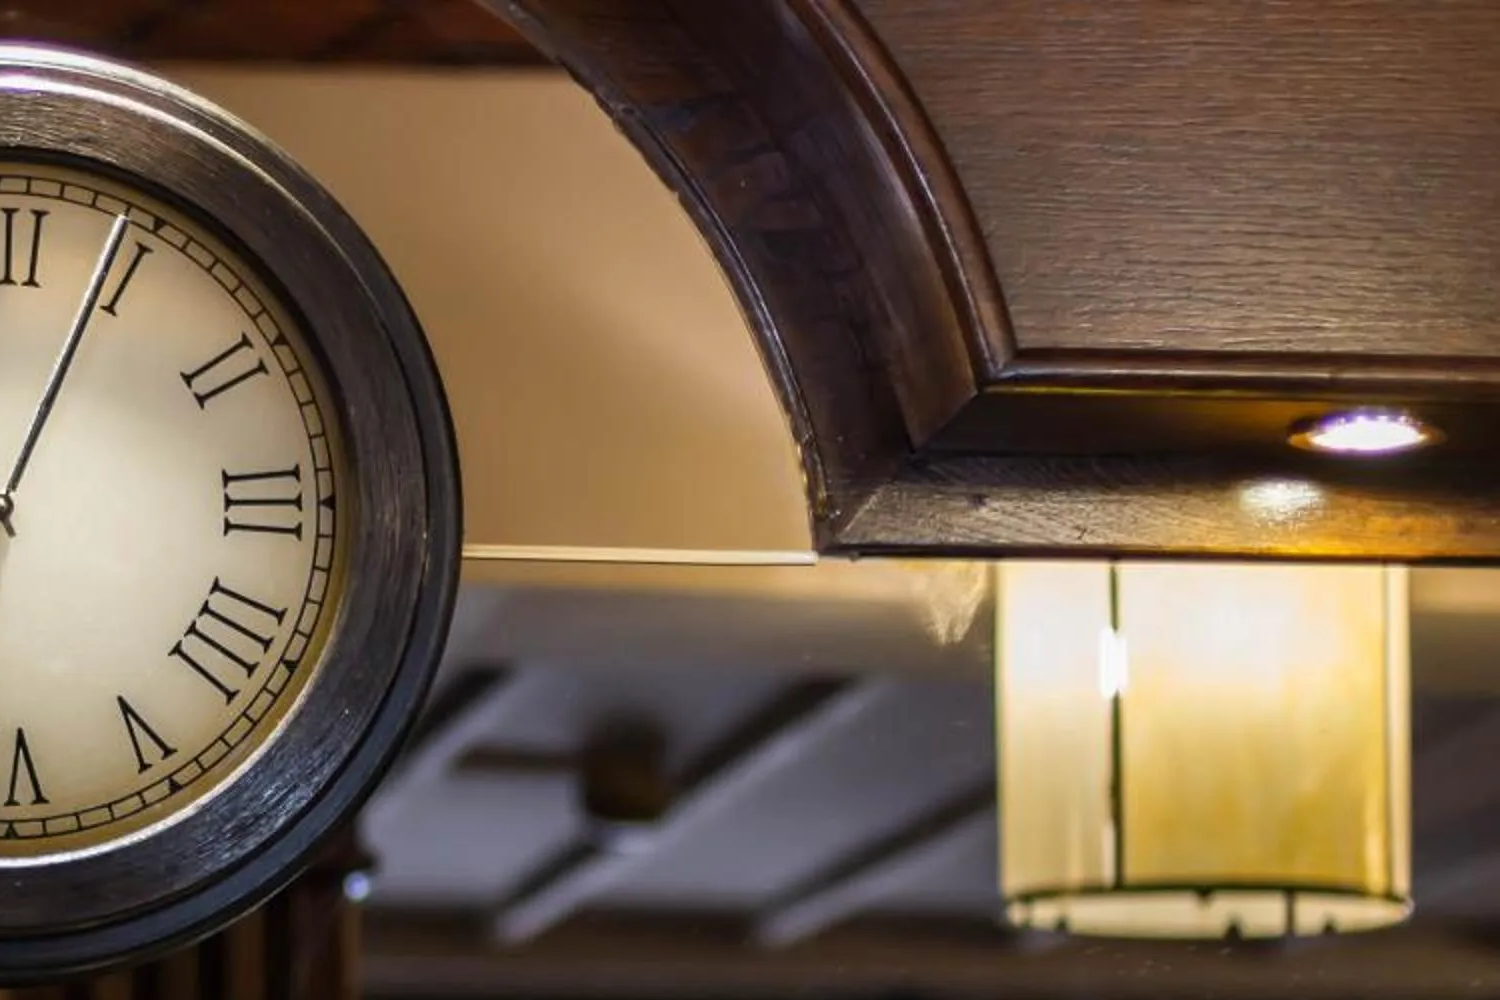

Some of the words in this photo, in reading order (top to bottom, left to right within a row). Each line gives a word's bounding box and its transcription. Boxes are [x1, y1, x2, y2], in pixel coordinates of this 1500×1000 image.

[180, 333, 270, 410] II
[222, 464, 302, 540] III
[169, 577, 288, 706] IIII
[118, 695, 178, 774] V
